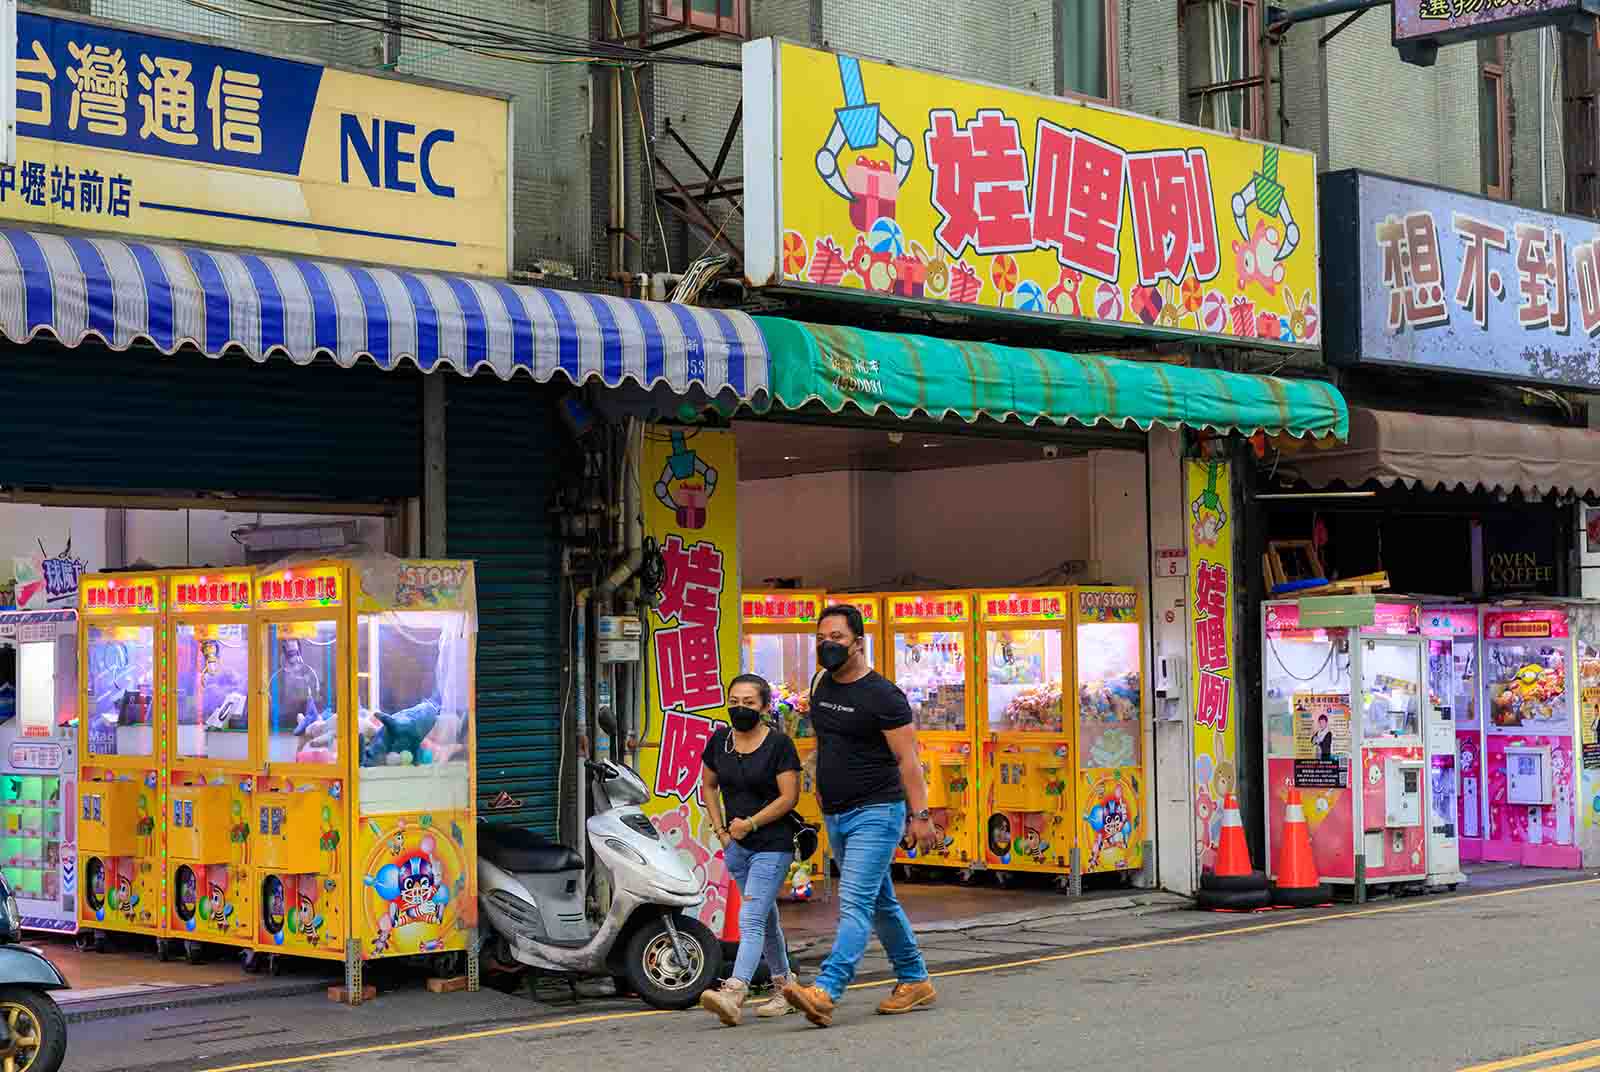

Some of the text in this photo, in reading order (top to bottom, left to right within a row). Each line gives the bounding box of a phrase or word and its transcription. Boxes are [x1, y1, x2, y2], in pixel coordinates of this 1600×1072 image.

[16, 40, 263, 156] 台灣通信
[339, 112, 457, 199] NEC
[0, 160, 134, 219] 中壢站前店
[925, 109, 1220, 287] 娃哩咧
[1376, 210, 1600, 339] 想不到
[406, 566, 467, 587] STORY
[1080, 592, 1137, 608] TOY STORY
[652, 535, 728, 805] 娃哩咧
[1194, 559, 1231, 733] 娃哩咧
